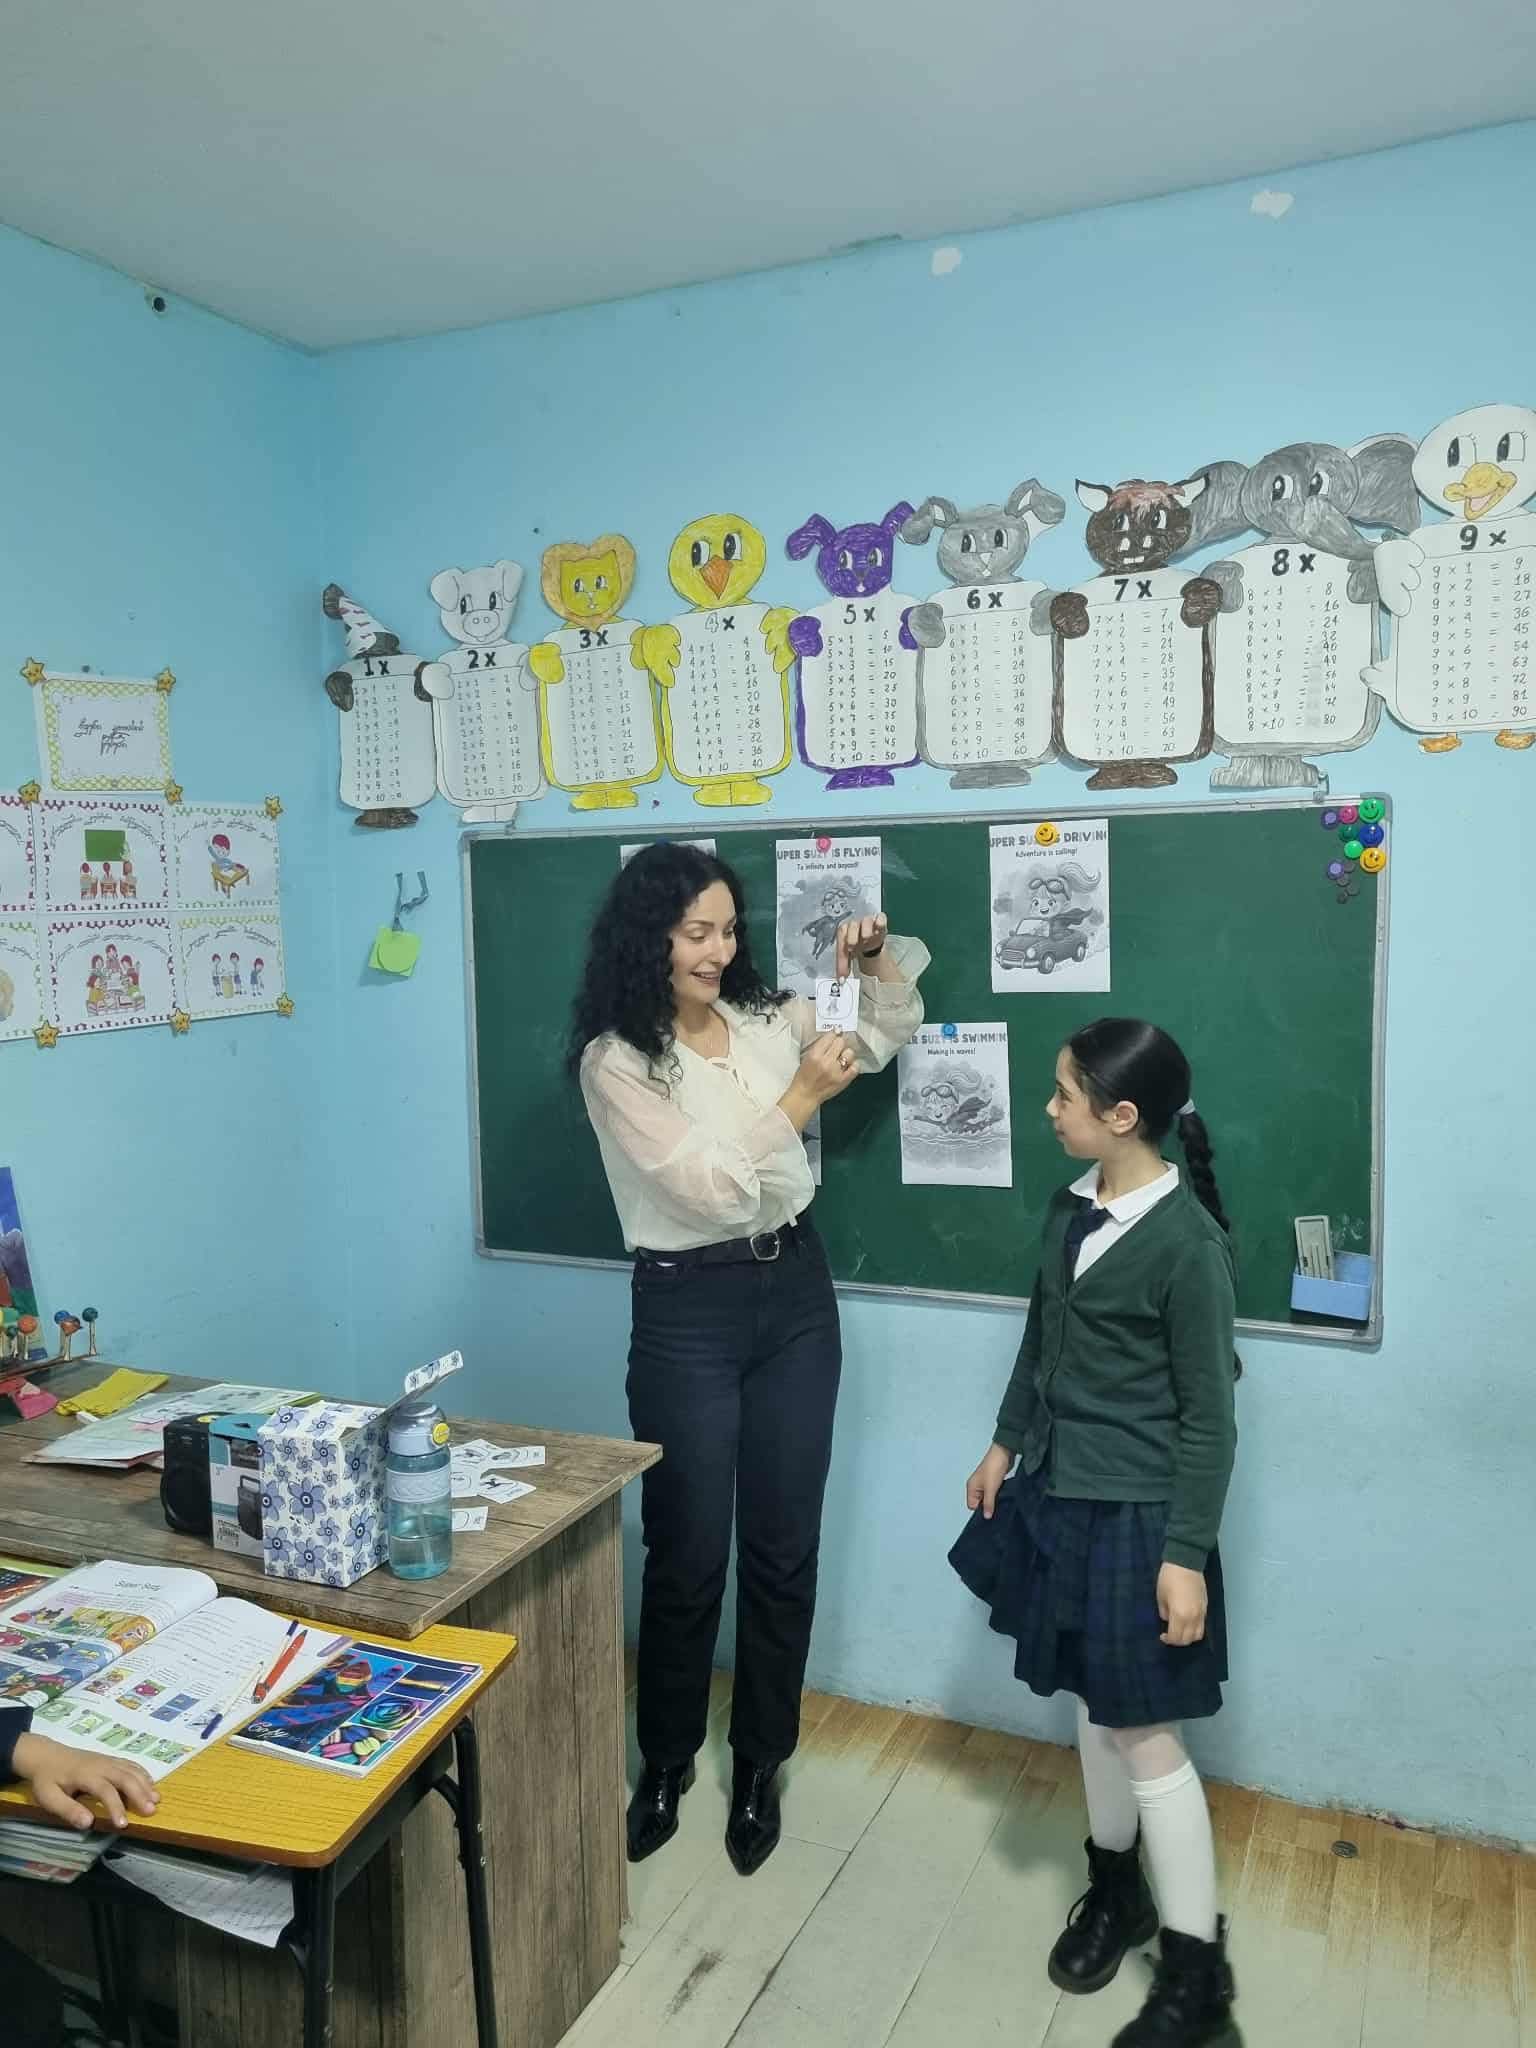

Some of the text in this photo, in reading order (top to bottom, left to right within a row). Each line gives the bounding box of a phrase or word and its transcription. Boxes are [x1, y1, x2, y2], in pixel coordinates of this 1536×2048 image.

[1460, 524, 1478, 551] 9
[1272, 549, 1289, 576] 8
[1432, 565, 1440, 578] 9
[1465, 561, 1472, 574] 1
[1514, 557, 1523, 570] 9
[1114, 578, 1130, 601] 7
[1248, 588, 1254, 600] 8
[1326, 582, 1332, 595] 8
[1432, 582, 1440, 594] 9
[1464, 578, 1472, 592] 2
[1513, 573, 1530, 586] 18
[967, 589, 980, 609] 6
[1432, 598, 1440, 610] 9
[1464, 595, 1472, 607] 3
[1513, 590, 1531, 602] 27
[705, 612, 719, 633] 4
[843, 604, 857, 624] 5
[1160, 608, 1168, 619] 7
[1433, 614, 1440, 626] 9
[1464, 612, 1471, 623] 4
[1513, 607, 1530, 620] 36
[1162, 622, 1173, 633] 14
[1432, 631, 1440, 643] 9
[1464, 628, 1472, 639] 5
[1513, 622, 1529, 634] 45
[580, 630, 591, 648] 3
[1432, 648, 1440, 658] 9
[1464, 644, 1471, 655] 6
[1513, 640, 1529, 651] 54
[364, 656, 374, 676] 1
[467, 650, 479, 669] 2
[885, 658, 894, 667] 15
[1432, 663, 1440, 675] 9
[1464, 662, 1471, 671] 7
[1512, 656, 1528, 668] 63
[849, 674, 855, 684] 4
[884, 671, 896, 680] 20
[974, 679, 980, 688] 5
[1012, 673, 1025, 685] 30
[1432, 680, 1439, 690] 9
[1462, 677, 1470, 688] 8
[1512, 673, 1527, 684] 72
[951, 695, 957, 705] 6
[974, 692, 980, 701] 6
[1432, 696, 1439, 707] 9
[1463, 694, 1470, 704] 9
[1513, 689, 1528, 701] 81
[1121, 716, 1127, 727] 8
[1162, 712, 1175, 724] 56
[1432, 712, 1438, 722] 9
[1463, 709, 1478, 720] 10
[1512, 705, 1527, 717] 90
[851, 740, 857, 751] 9
[885, 737, 896, 747] 45
[952, 751, 958, 760] 6
[977, 747, 988, 759] 10
[1014, 745, 1027, 755] 60
[885, 752, 896, 760] 50
